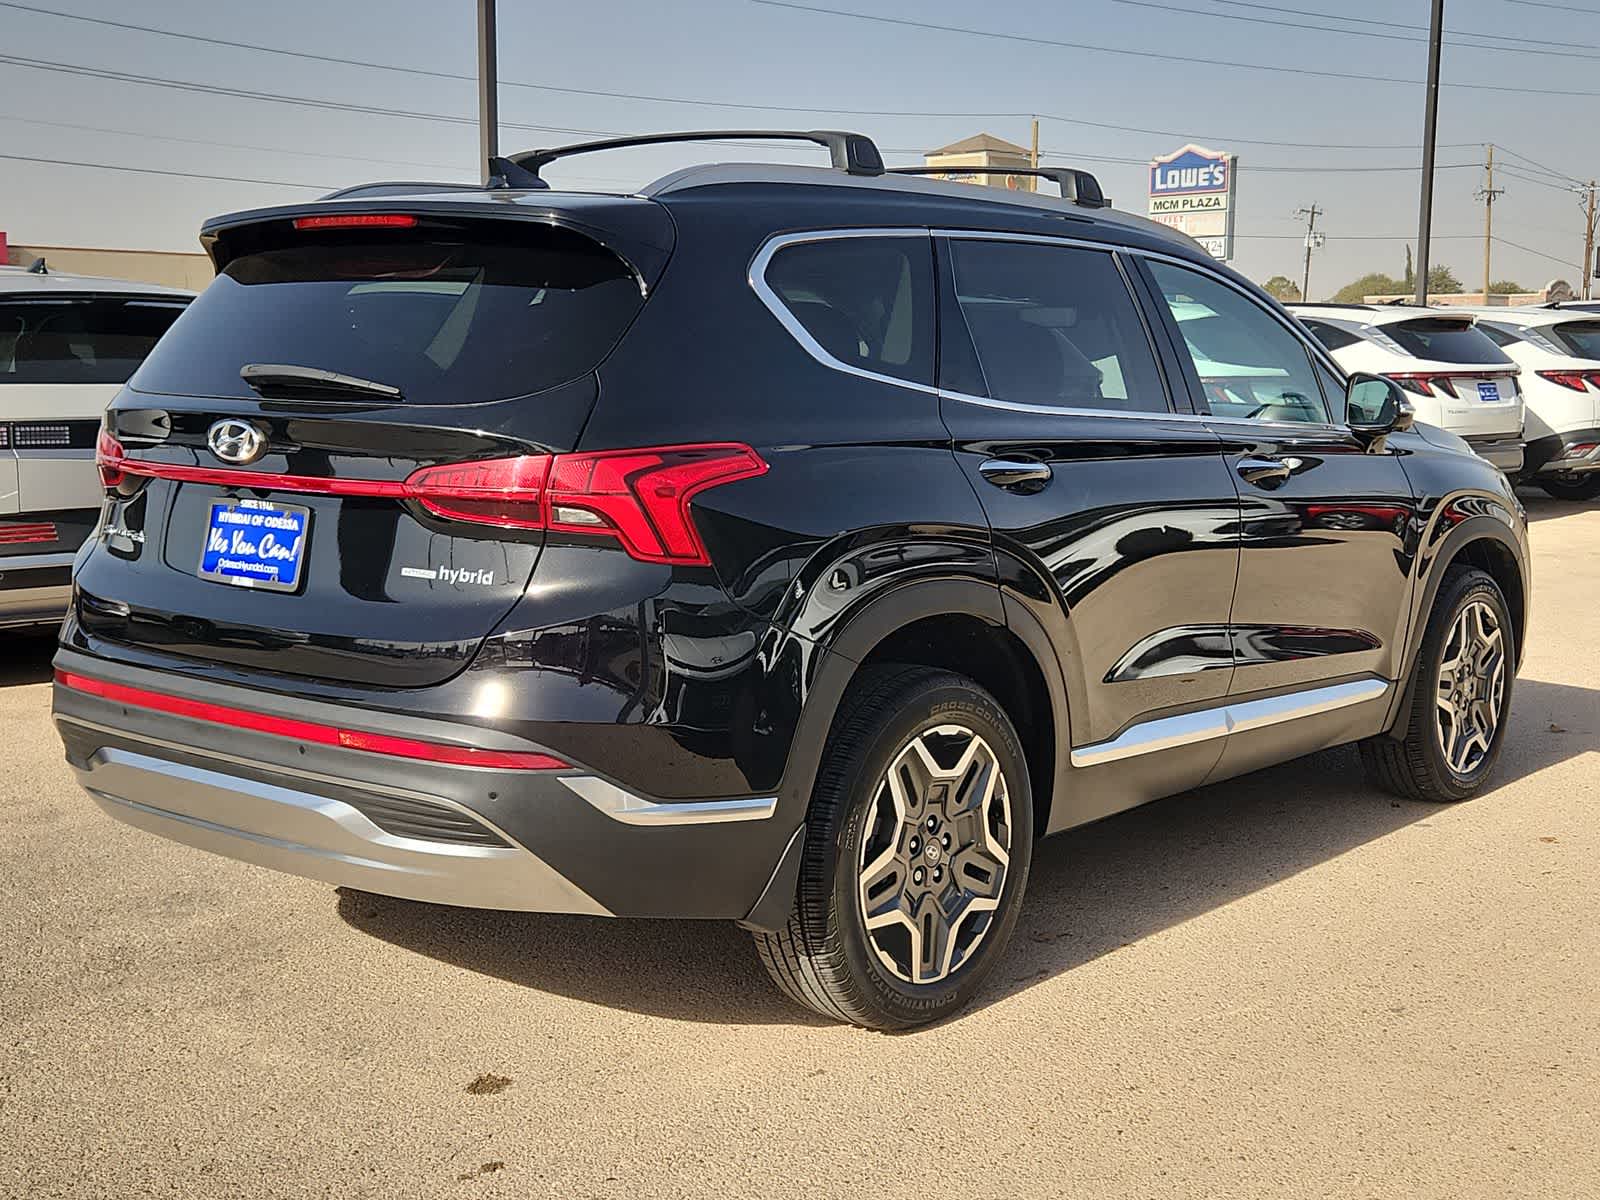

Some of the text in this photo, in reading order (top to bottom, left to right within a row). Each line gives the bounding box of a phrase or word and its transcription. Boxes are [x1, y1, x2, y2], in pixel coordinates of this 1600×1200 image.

[1155, 164, 1224, 190] LOWE'S
[1153, 198, 1221, 210] MCM PLAZA
[218, 512, 299, 531] HYUNDAI OF ODESSA
[208, 528, 300, 561] Yes You Can!
[439, 566, 494, 585] hybrid
